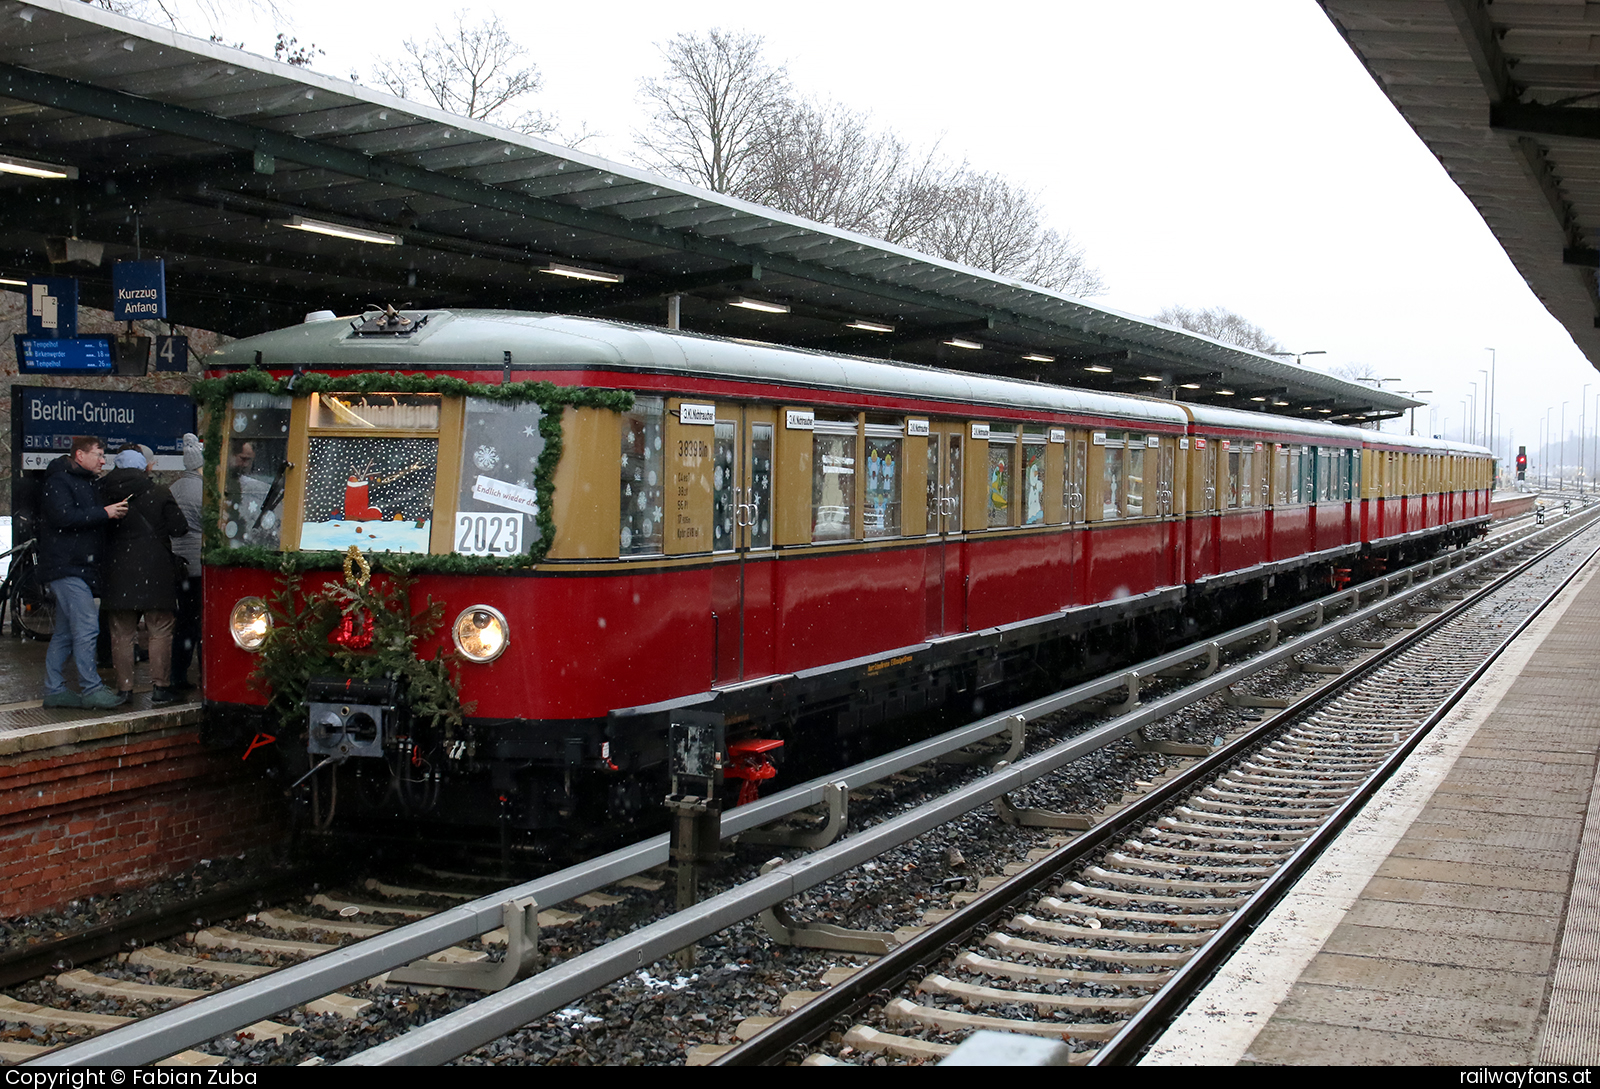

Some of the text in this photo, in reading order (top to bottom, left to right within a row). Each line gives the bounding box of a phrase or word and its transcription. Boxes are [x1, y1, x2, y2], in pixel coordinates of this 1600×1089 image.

[118, 288, 157, 300] Kurzzug
[124, 302, 158, 314] Anfang
[33, 340, 59, 349] Tempelhof
[160, 337, 175, 363] 4
[36, 360, 61, 368] Tempelhof
[31, 399, 135, 424] Berlin-Grünau
[678, 440, 698, 457] 3839
[476, 484, 502, 498] Endlich
[502, 493, 526, 505] wieder
[458, 515, 519, 553] 2023
